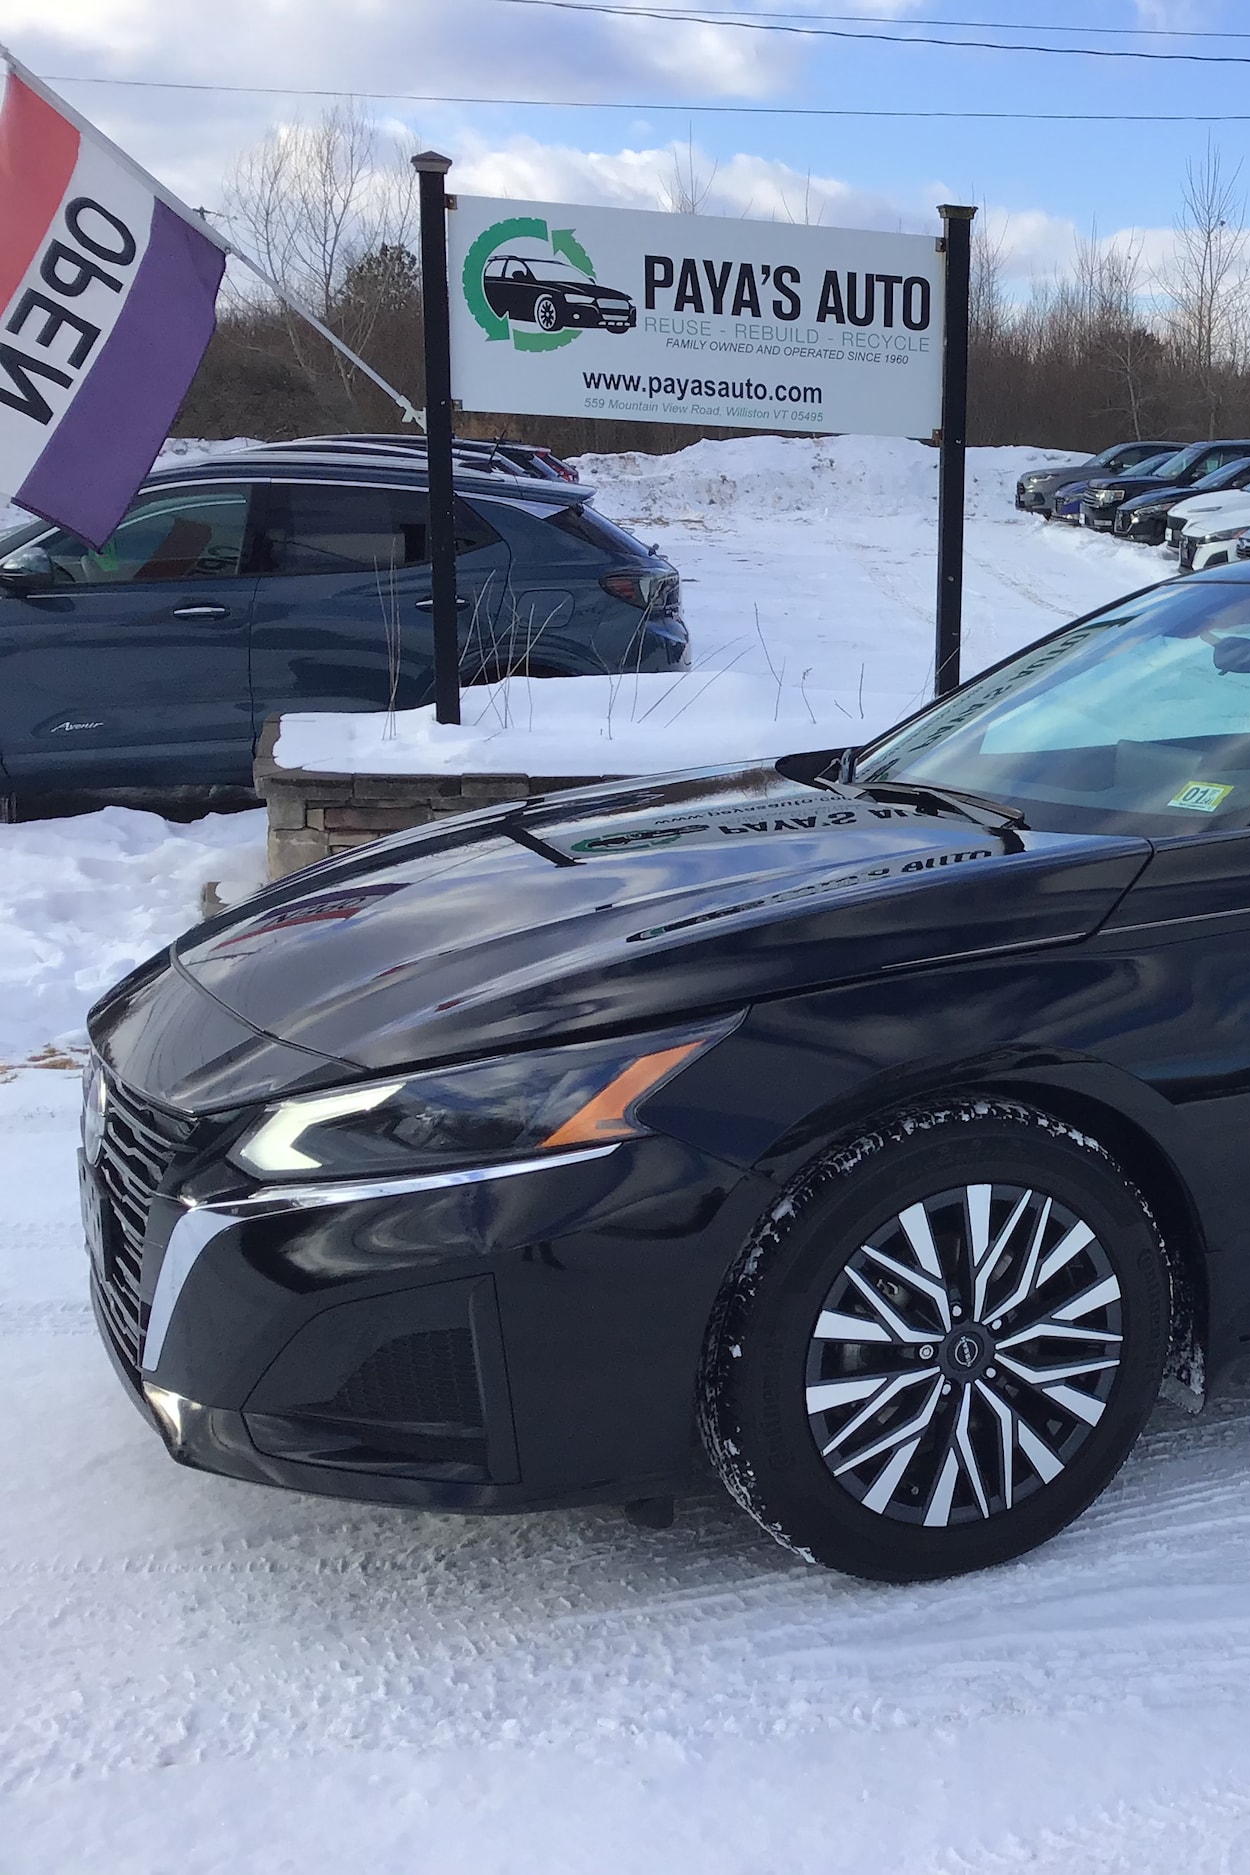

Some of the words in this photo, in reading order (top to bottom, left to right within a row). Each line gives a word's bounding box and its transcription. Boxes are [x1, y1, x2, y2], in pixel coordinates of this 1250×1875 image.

[644, 254, 801, 321] PAYA'S
[816, 270, 931, 331] AUTO
[644, 317, 711, 337] REUSE
[735, 323, 819, 344] REBUILD
[842, 332, 931, 352] RECYCLE
[665, 338, 708, 351] FAMILY
[709, 341, 754, 354] OWNED
[756, 344, 784, 356] AND
[784, 346, 845, 361] OPERATED
[847, 351, 881, 363] SINCE
[884, 354, 909, 365] 1960
[582, 371, 823, 404] www.payasauto.com
[584, 398, 605, 409] 559
[607, 399, 659, 412] Mountain
[662, 402, 688, 414] View
[725, 406, 770, 419] Williston
[772, 410, 789, 420] VT
[790, 411, 824, 423] 05495
[1182, 786, 1210, 804] 01
